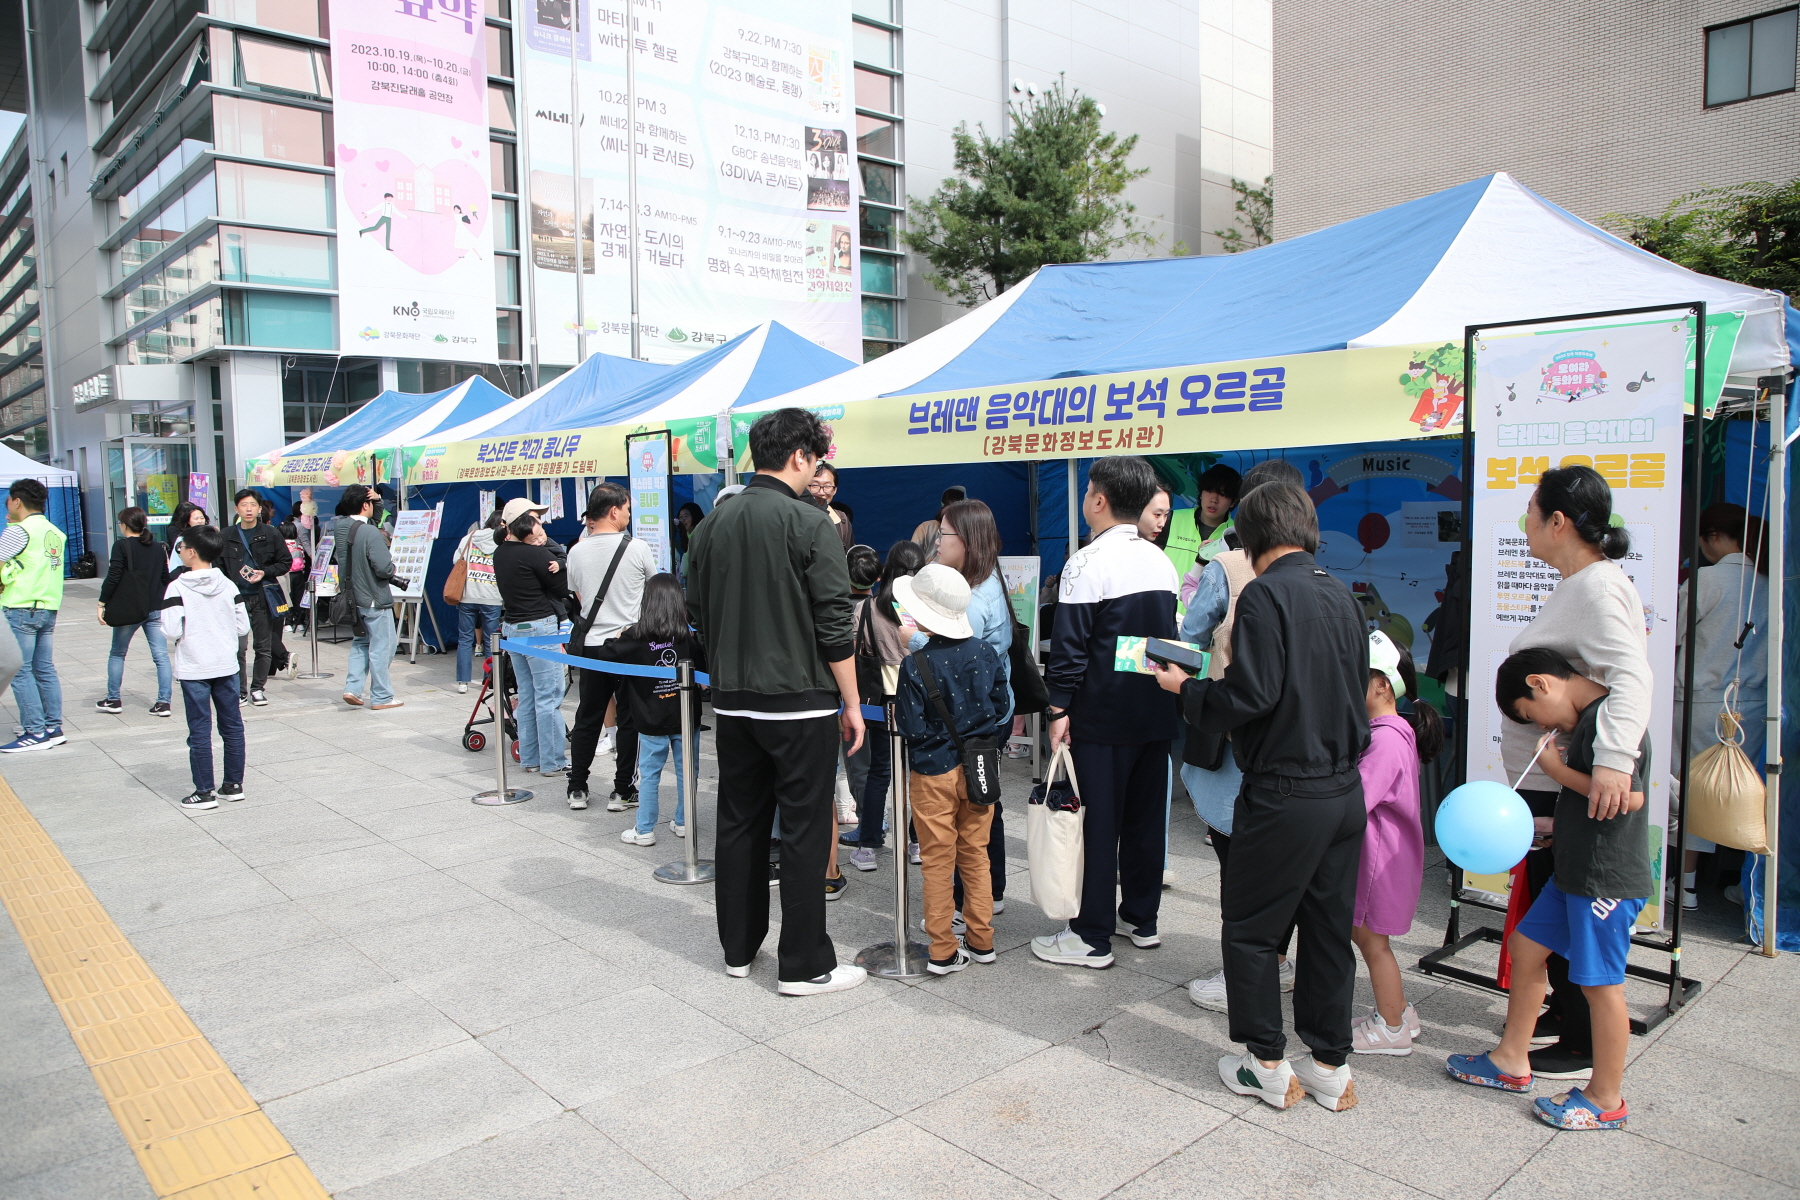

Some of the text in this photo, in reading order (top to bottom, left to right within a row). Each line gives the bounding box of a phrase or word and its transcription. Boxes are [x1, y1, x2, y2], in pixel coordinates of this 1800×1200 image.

[634, 37, 648, 54] 투
[652, 42, 678, 63] 첼로
[737, 28, 802, 55] 9.22. PM 7:30
[723, 45, 803, 80] 강북구민과 함께하는
[402, 66, 429, 80] 14:00
[371, 80, 453, 103] 강북진달래홀 공연장
[637, 97, 657, 112] PM
[659, 102, 667, 115] 3
[600, 115, 687, 145] 씨네2과 함께하는
[734, 124, 800, 150] 12.13. PM 7:30
[732, 145, 802, 171] GBCF 송년음악회
[654, 209, 698, 226] AM10-PM5
[644, 229, 684, 250] 도시의
[718, 225, 803, 250] 9.1~9.23 AM10-PM5
[645, 248, 684, 269] 거닐다
[728, 246, 803, 265] 모나리자의 비밀을 찾아라
[707, 257, 804, 284] 명화 속 과학체험전
[383, 331, 421, 341] 강북문화재단
[452, 335, 477, 345] 강북구
[601, 322, 727, 345] 강북문재단 강북구
[1558, 362, 1589, 374] 모여라
[1552, 374, 1582, 386] 동화의
[908, 366, 1286, 435] 브레맨 음악대의 보석 오르골
[983, 424, 1163, 456] (강북문화정보도서관)
[1497, 418, 1654, 447] 브레멘 음악대의
[477, 434, 582, 463] 북스타트 책과 콩나무
[1362, 456, 1411, 472] Music
[639, 492, 660, 508] 콩나무
[1497, 549, 1518, 557] 브레멘
[1624, 552, 1643, 561] 오는
[1497, 559, 1531, 568] 사운드북을
[1533, 561, 1547, 569] 보고
[1497, 571, 1518, 579] 브레멘
[1519, 571, 1546, 580] 음악대도
[1497, 581, 1554, 592] 읽을 때마다 음악을
[1497, 592, 1510, 601] 투명
[1511, 593, 1539, 602] 오르골에
[1496, 602, 1536, 613] 동물스티커를
[1496, 613, 1517, 622] 예쁘게
[976, 754, 988, 794] adidas
